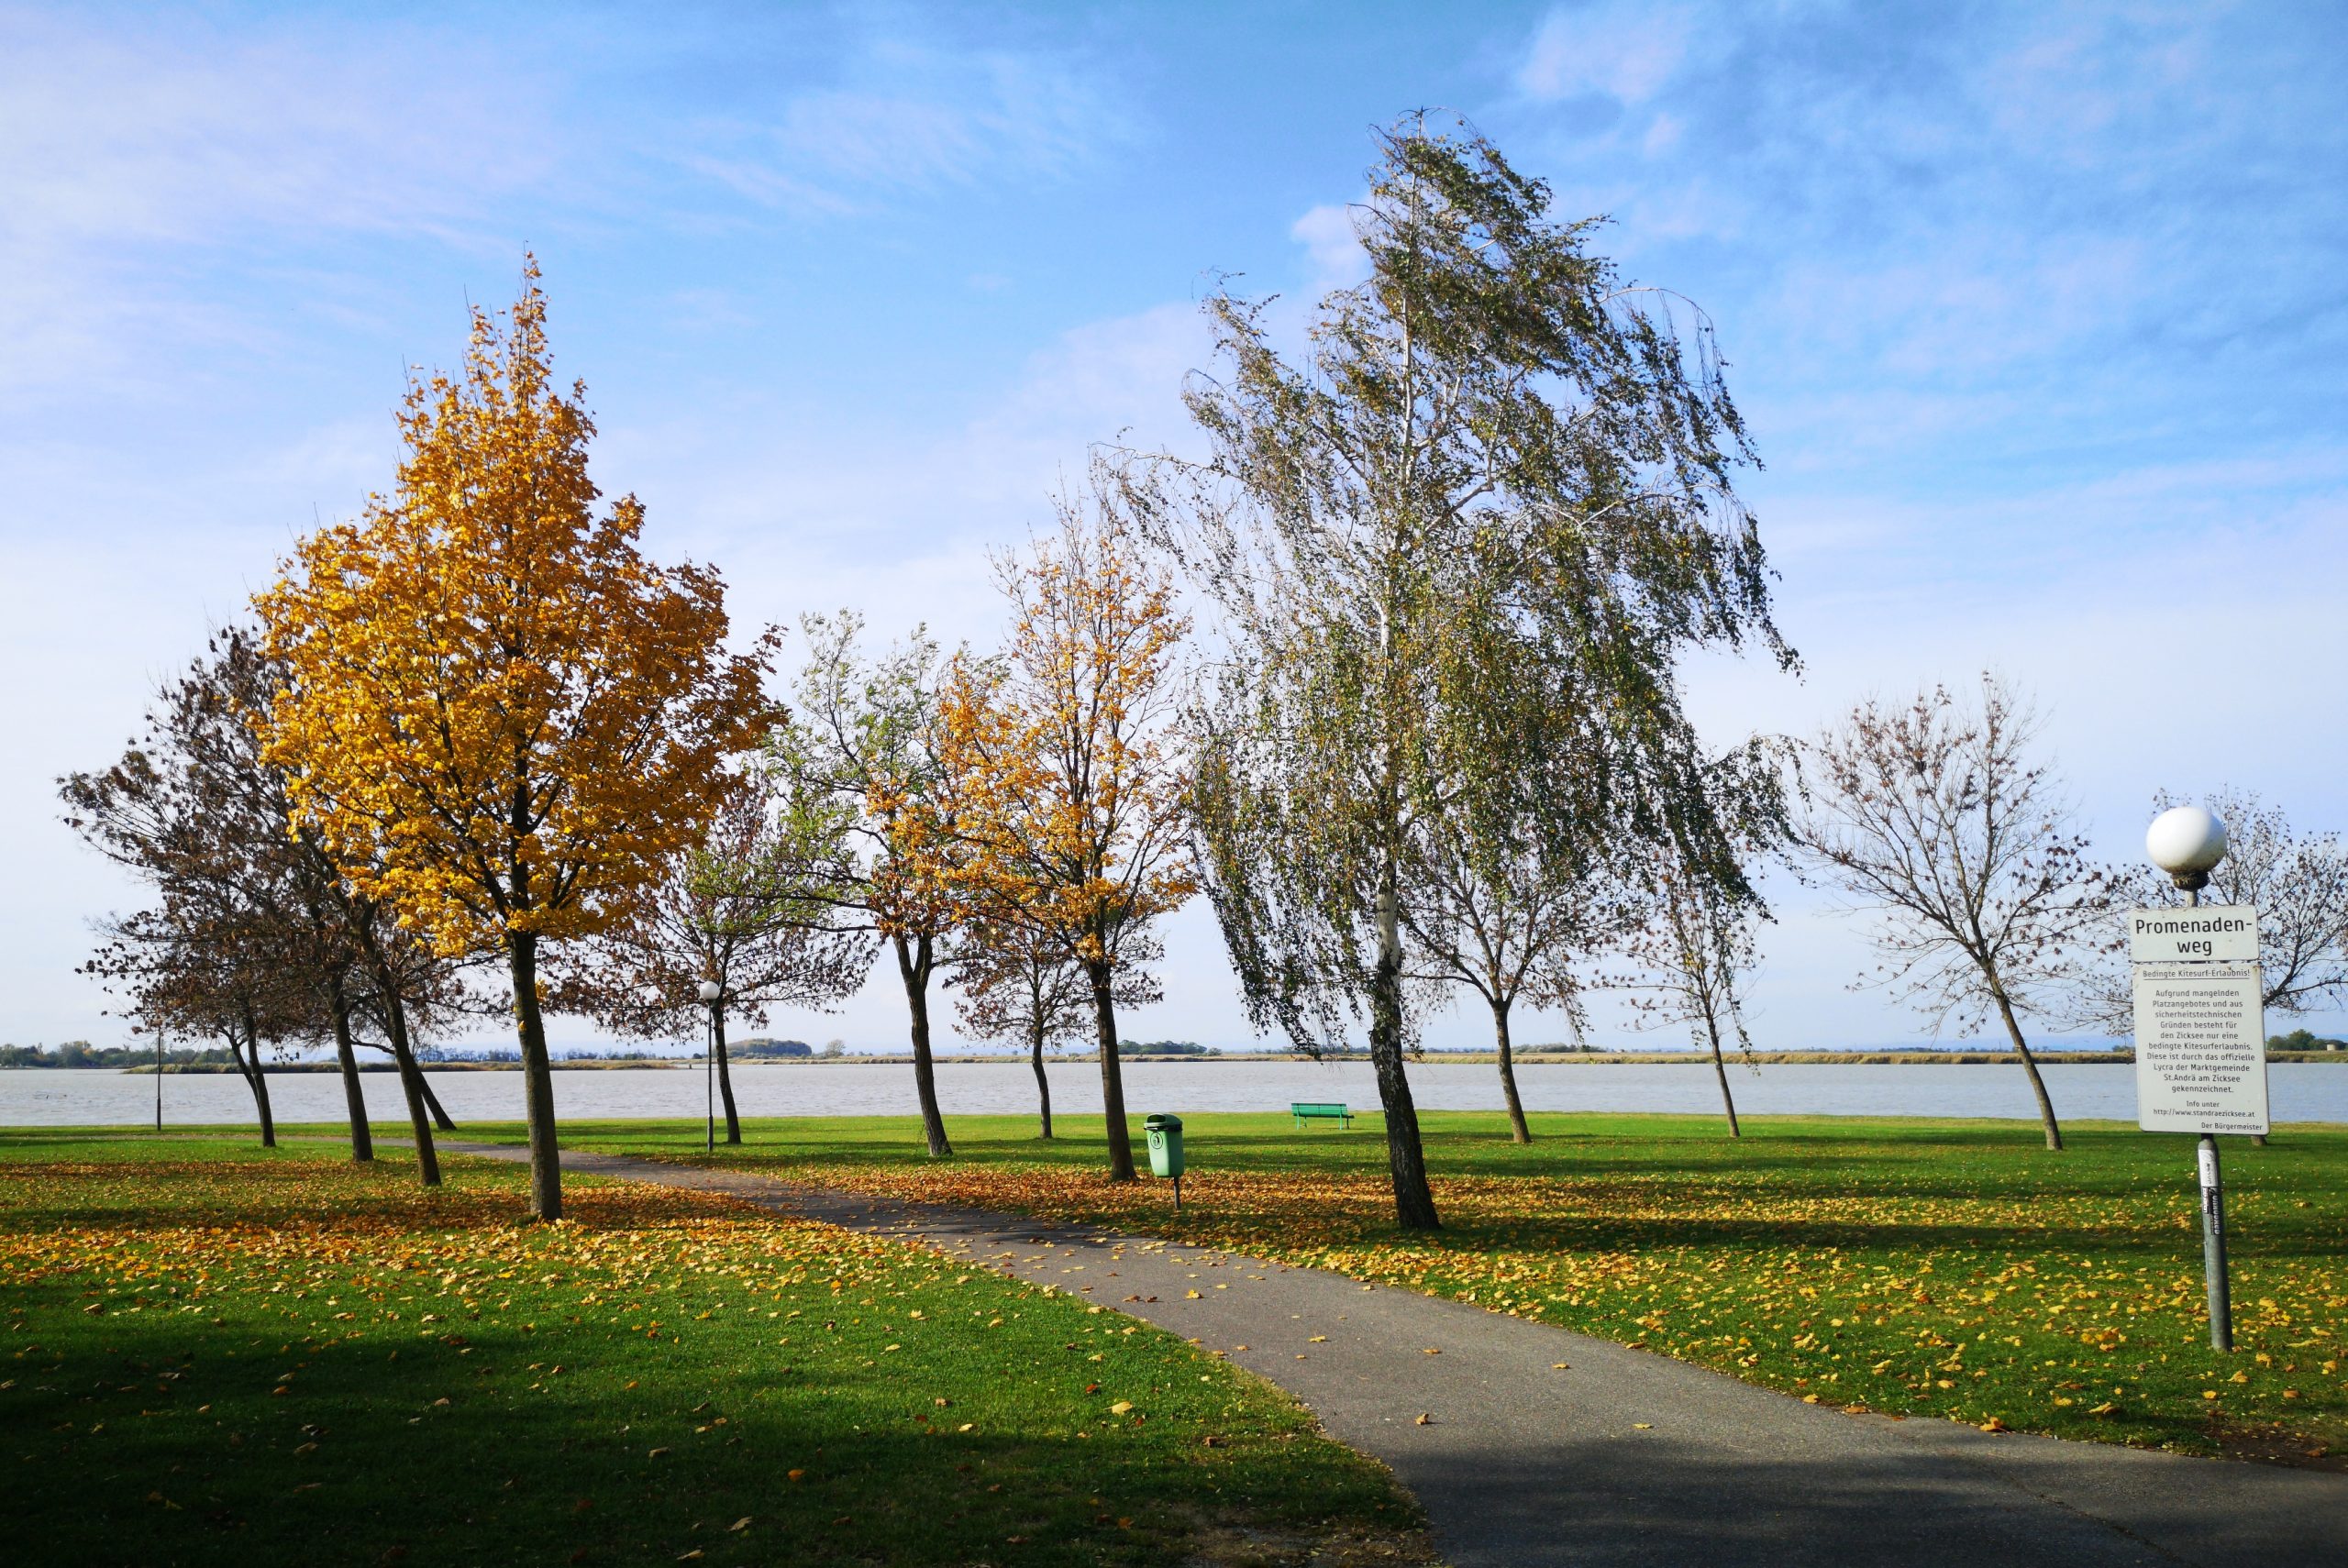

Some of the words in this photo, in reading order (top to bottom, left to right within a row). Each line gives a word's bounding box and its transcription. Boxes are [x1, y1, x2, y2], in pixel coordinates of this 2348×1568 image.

[2136, 917, 2252, 934] Promenaden-
[2177, 941, 2212, 956] weg
[2153, 1109, 2254, 1117] http://www.standraezicksee.at
